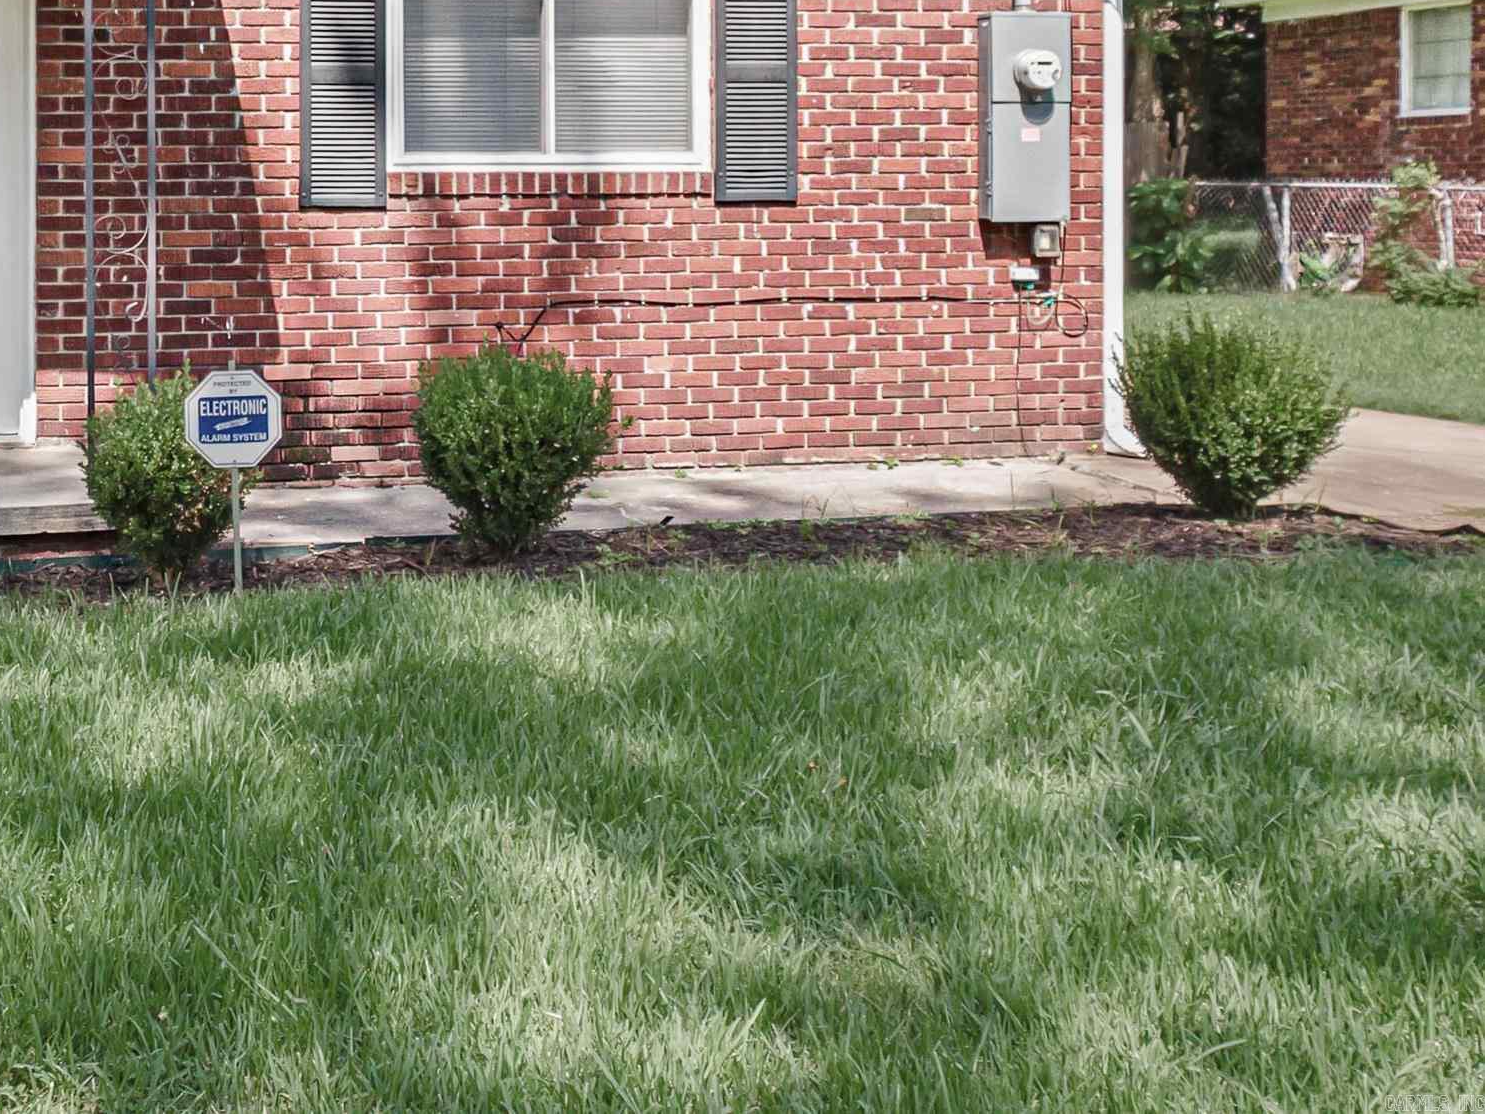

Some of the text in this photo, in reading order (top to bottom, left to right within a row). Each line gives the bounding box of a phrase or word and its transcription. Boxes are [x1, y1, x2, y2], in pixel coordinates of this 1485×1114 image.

[200, 399, 267, 416] ELECTRONIC
[201, 432, 267, 442] ALARM SYSTEM
